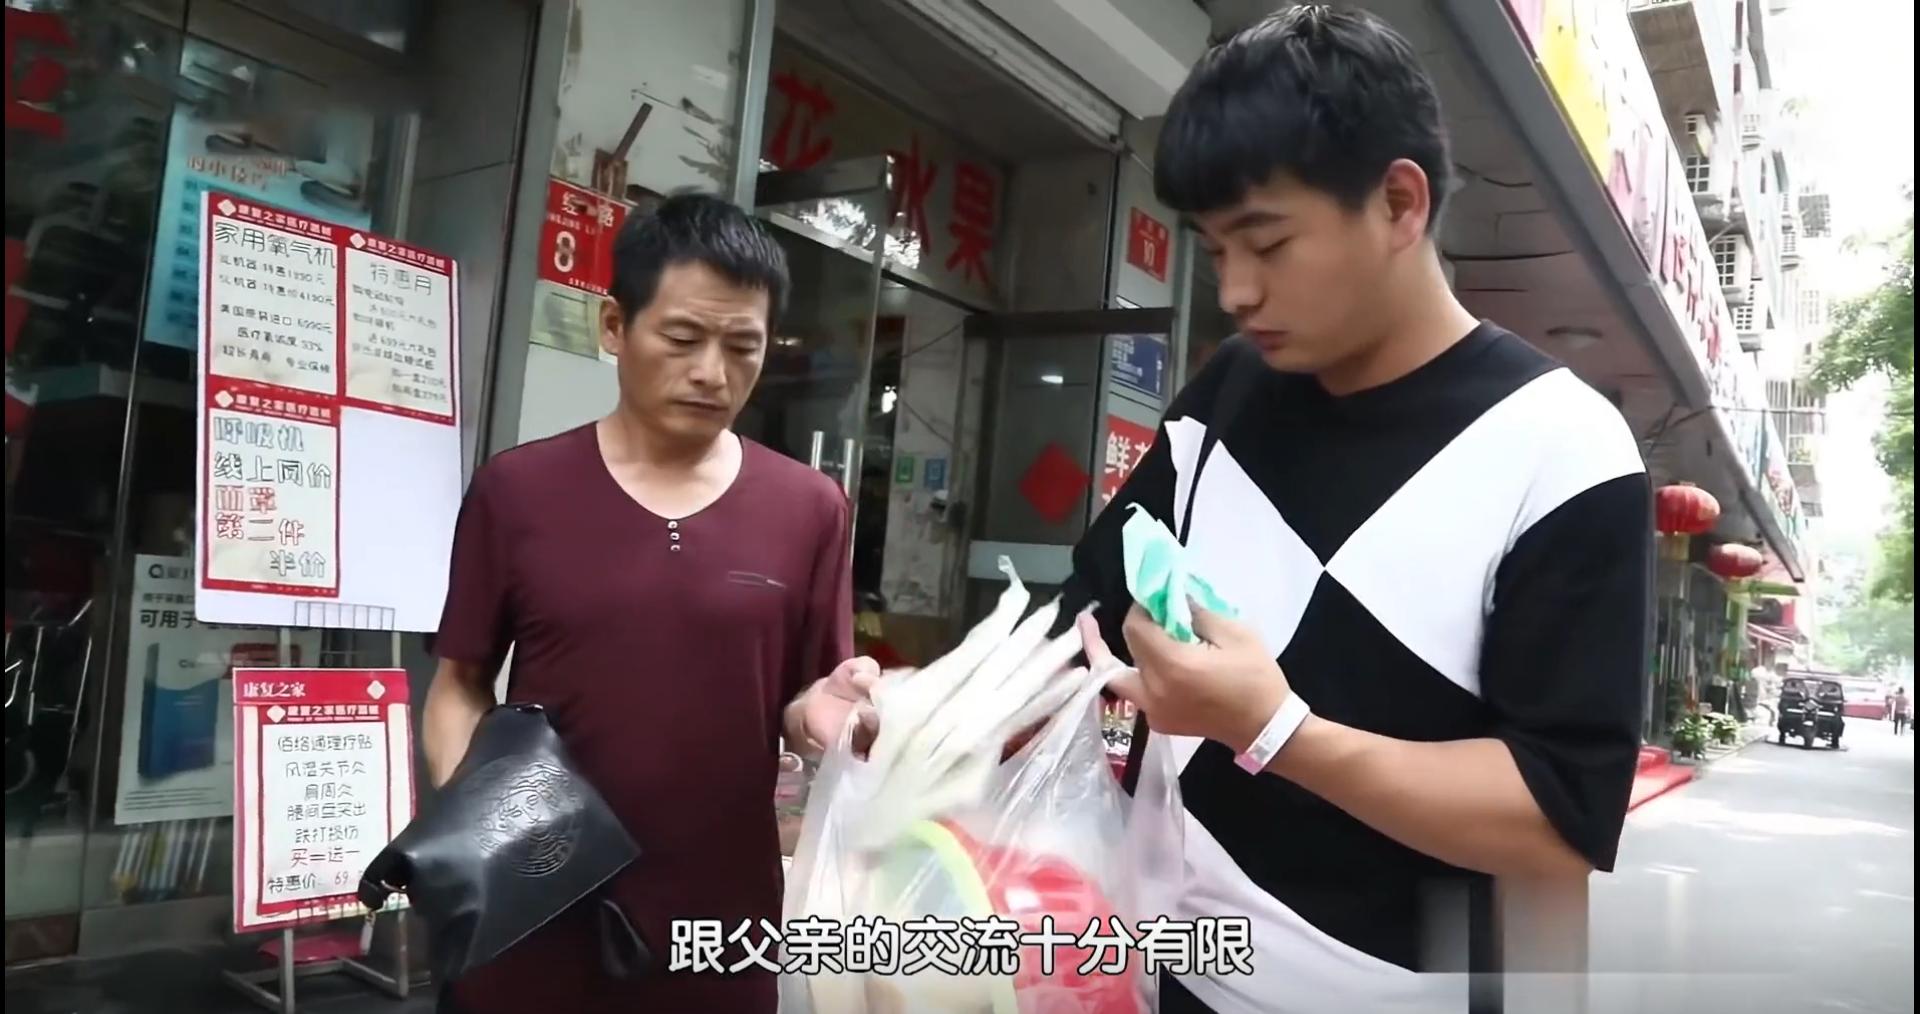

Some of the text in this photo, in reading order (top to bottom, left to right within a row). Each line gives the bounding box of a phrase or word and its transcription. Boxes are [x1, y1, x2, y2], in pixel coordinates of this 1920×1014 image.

[562, 192, 614, 227] 经路
[214, 221, 336, 269] 家用氧气机
[554, 231, 575, 272] 8
[214, 417, 304, 452] 呼吸机
[214, 452, 331, 488] 线上同价
[215, 485, 277, 514] 面罩
[215, 513, 305, 546] 第二件
[270, 550, 326, 578] 半价
[295, 825, 359, 844] 跌打损伤
[291, 847, 360, 868] 买二送一
